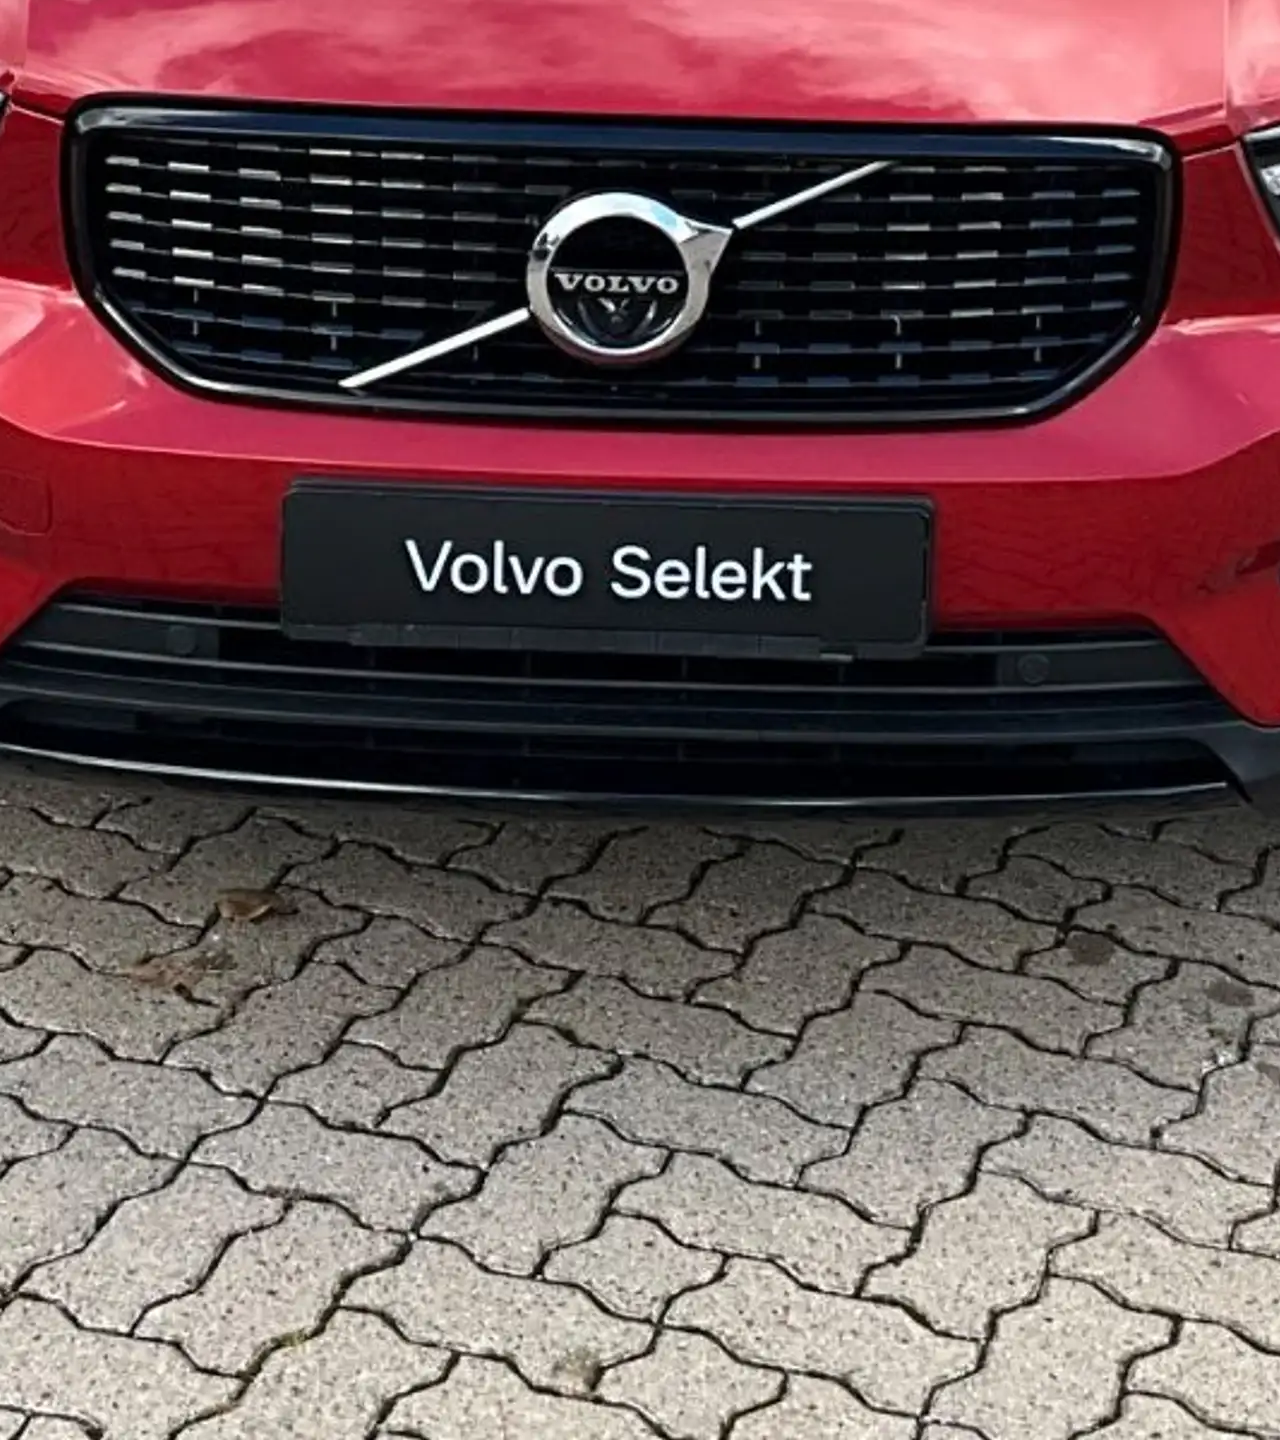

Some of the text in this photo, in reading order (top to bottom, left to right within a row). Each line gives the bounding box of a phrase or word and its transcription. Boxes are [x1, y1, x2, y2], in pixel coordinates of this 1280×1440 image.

[554, 273, 679, 294] VOLVO
[405, 539, 813, 602] Volvo Selekt
